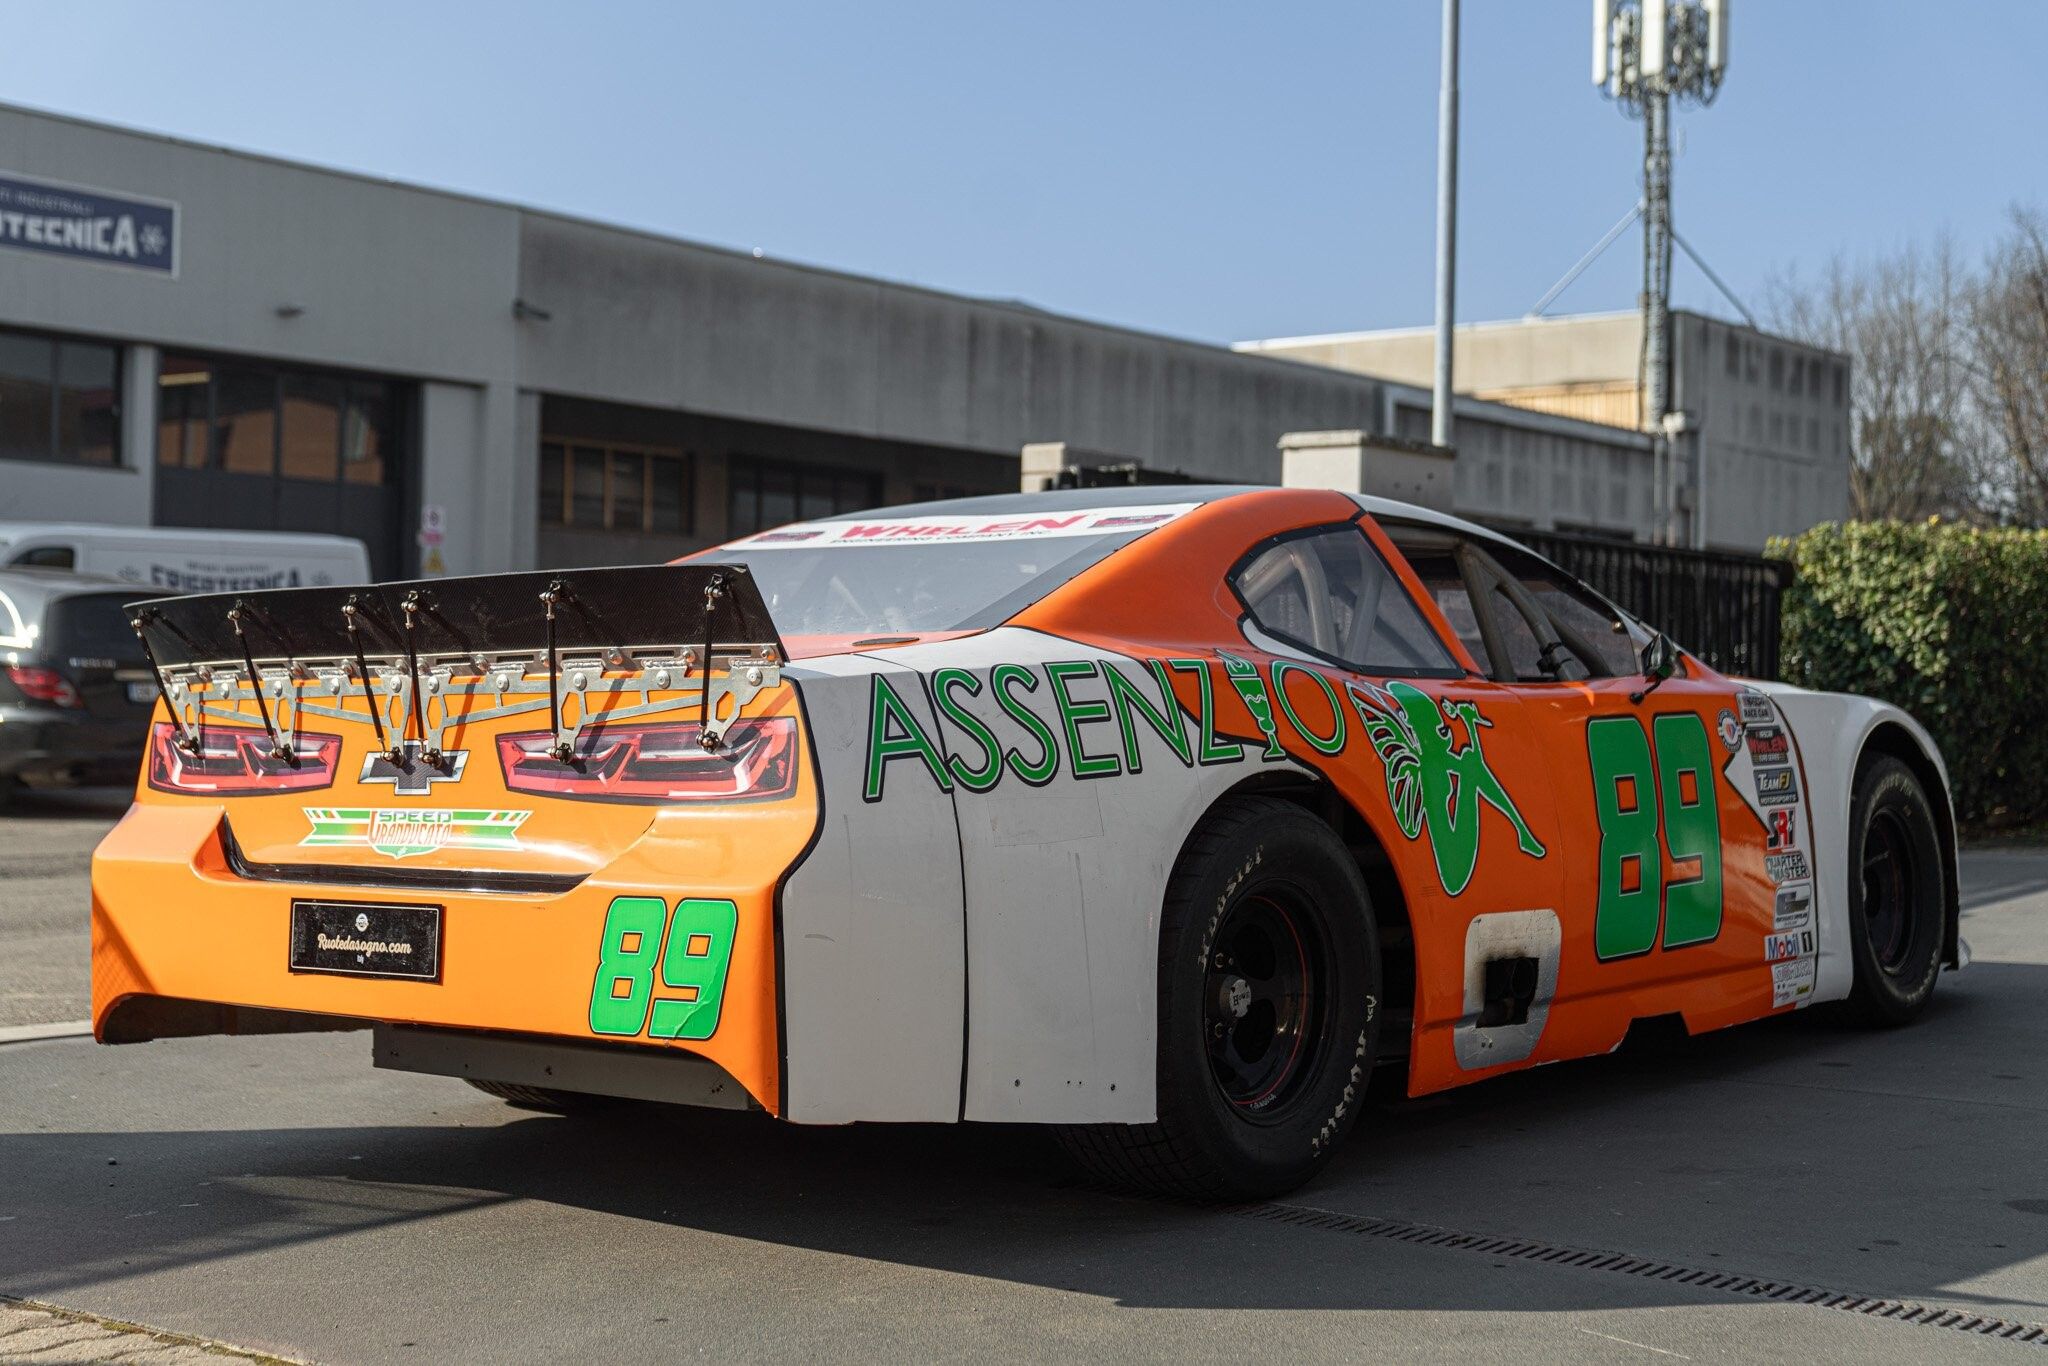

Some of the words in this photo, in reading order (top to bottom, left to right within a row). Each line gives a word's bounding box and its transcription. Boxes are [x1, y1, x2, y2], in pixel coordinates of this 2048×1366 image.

[0, 212, 138, 258] TECNICA
[841, 515, 1086, 539] WHELEN
[862, 650, 1347, 803] ASSENZIO
[379, 810, 452, 823] SPEED
[1587, 711, 1723, 963] 89
[317, 933, 412, 957] Ruotedasogno.com
[1767, 933, 1799, 959] Mobil
[588, 895, 739, 1041] 89
